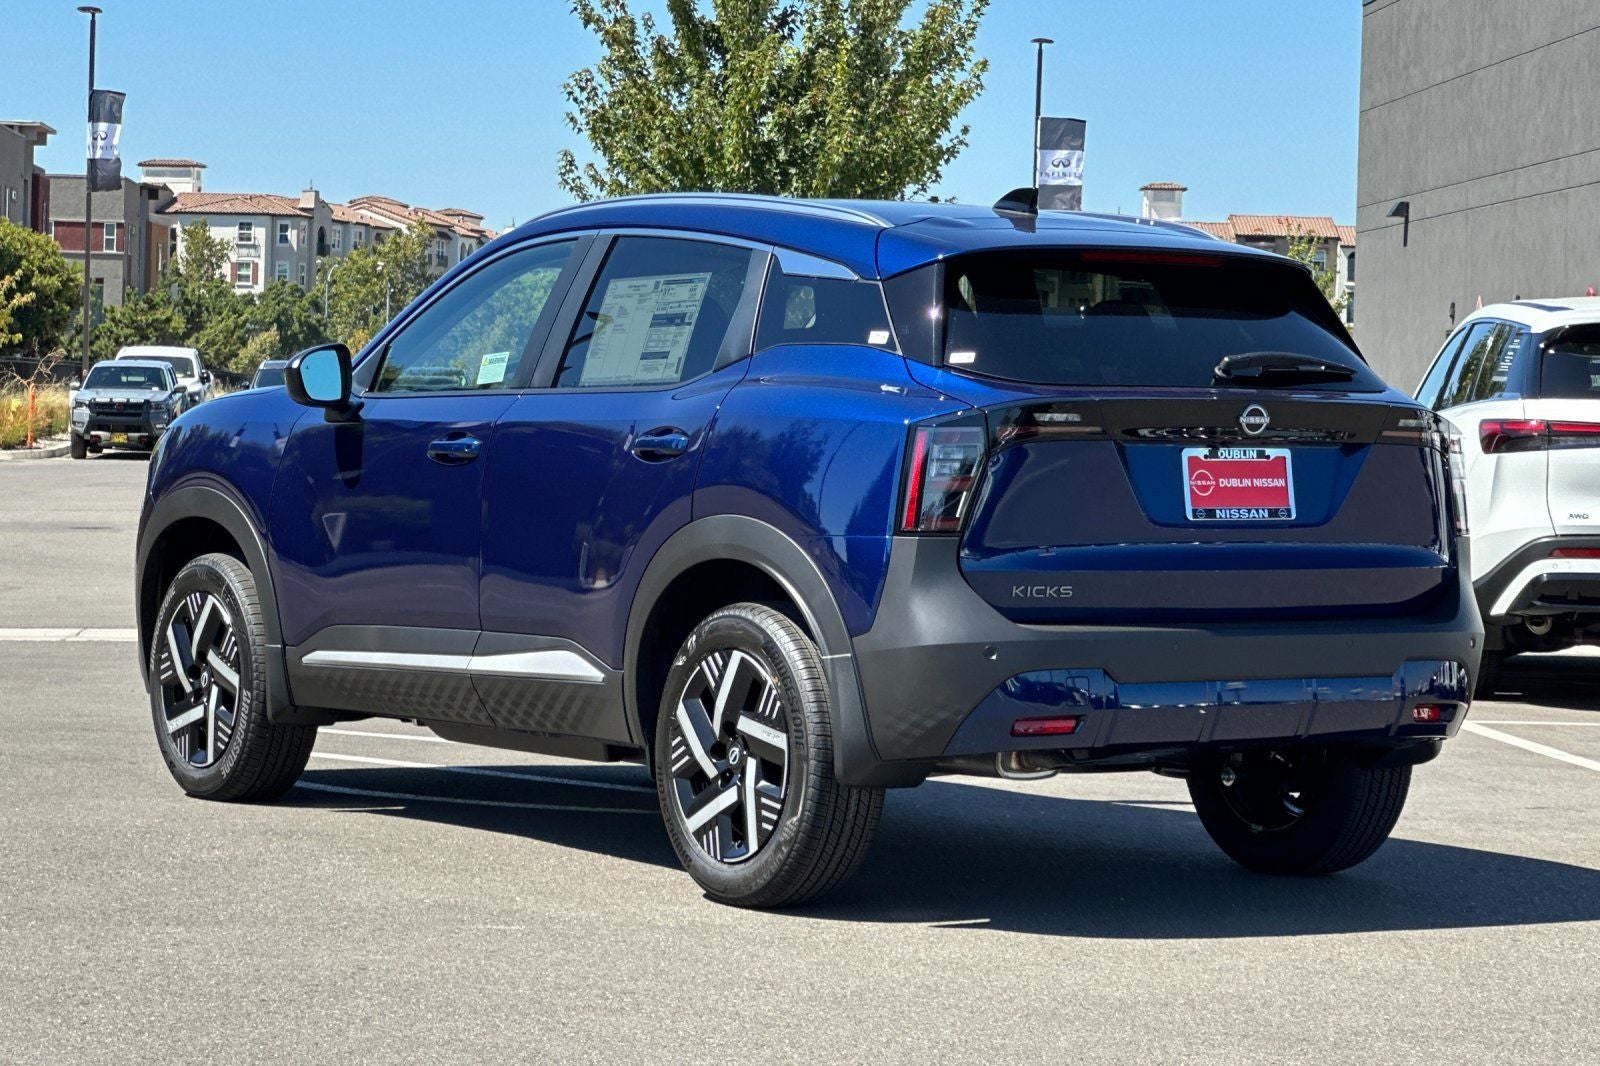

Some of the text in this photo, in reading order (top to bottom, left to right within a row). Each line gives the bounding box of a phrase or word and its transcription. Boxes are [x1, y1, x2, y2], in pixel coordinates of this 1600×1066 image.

[1239, 416, 1270, 424] NISSAN
[1218, 449, 1257, 459] DUBLIN
[1218, 478, 1286, 487] DUBLIN NISSAN
[1215, 509, 1269, 518] NISSAN
[1012, 585, 1073, 598] KICKS
[220, 688, 251, 780] BRIDGESTONE
